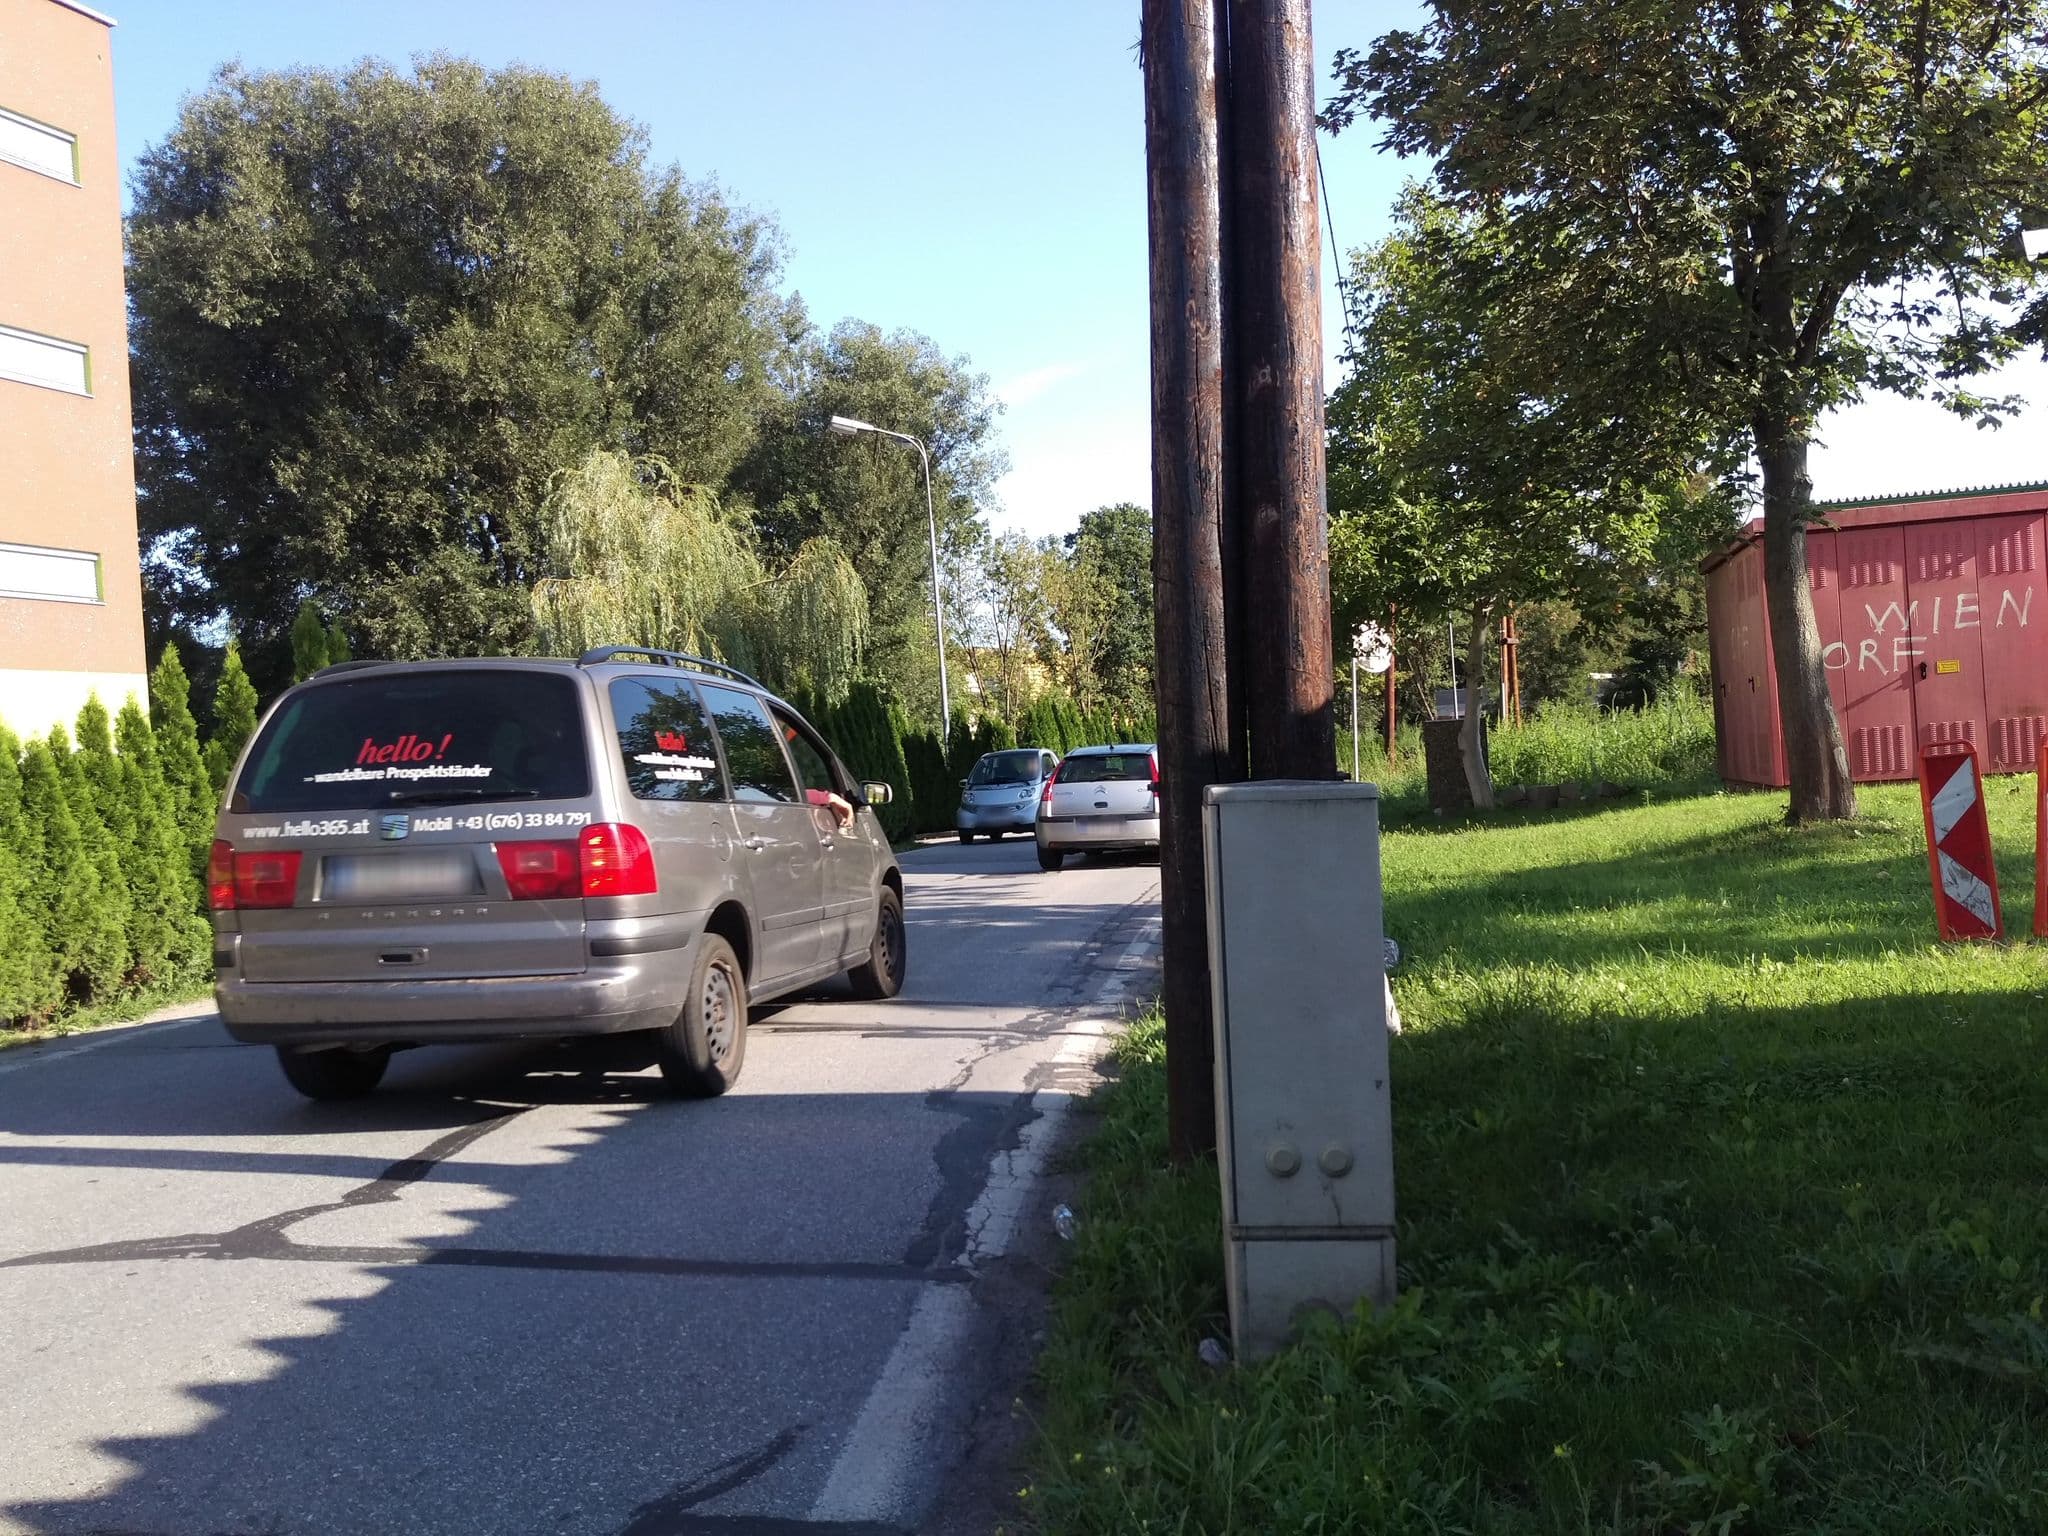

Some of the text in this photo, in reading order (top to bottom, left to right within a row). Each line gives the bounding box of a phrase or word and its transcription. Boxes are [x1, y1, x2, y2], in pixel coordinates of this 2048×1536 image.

[1864, 586, 2034, 635] WIEN
[1823, 636, 1927, 676] ORF
[314, 764, 493, 783] wandelbare Prospektständer
[243, 819, 370, 838] www.hello365.at
[413, 812, 592, 832] Mobil +43 (676) 33 84 791
